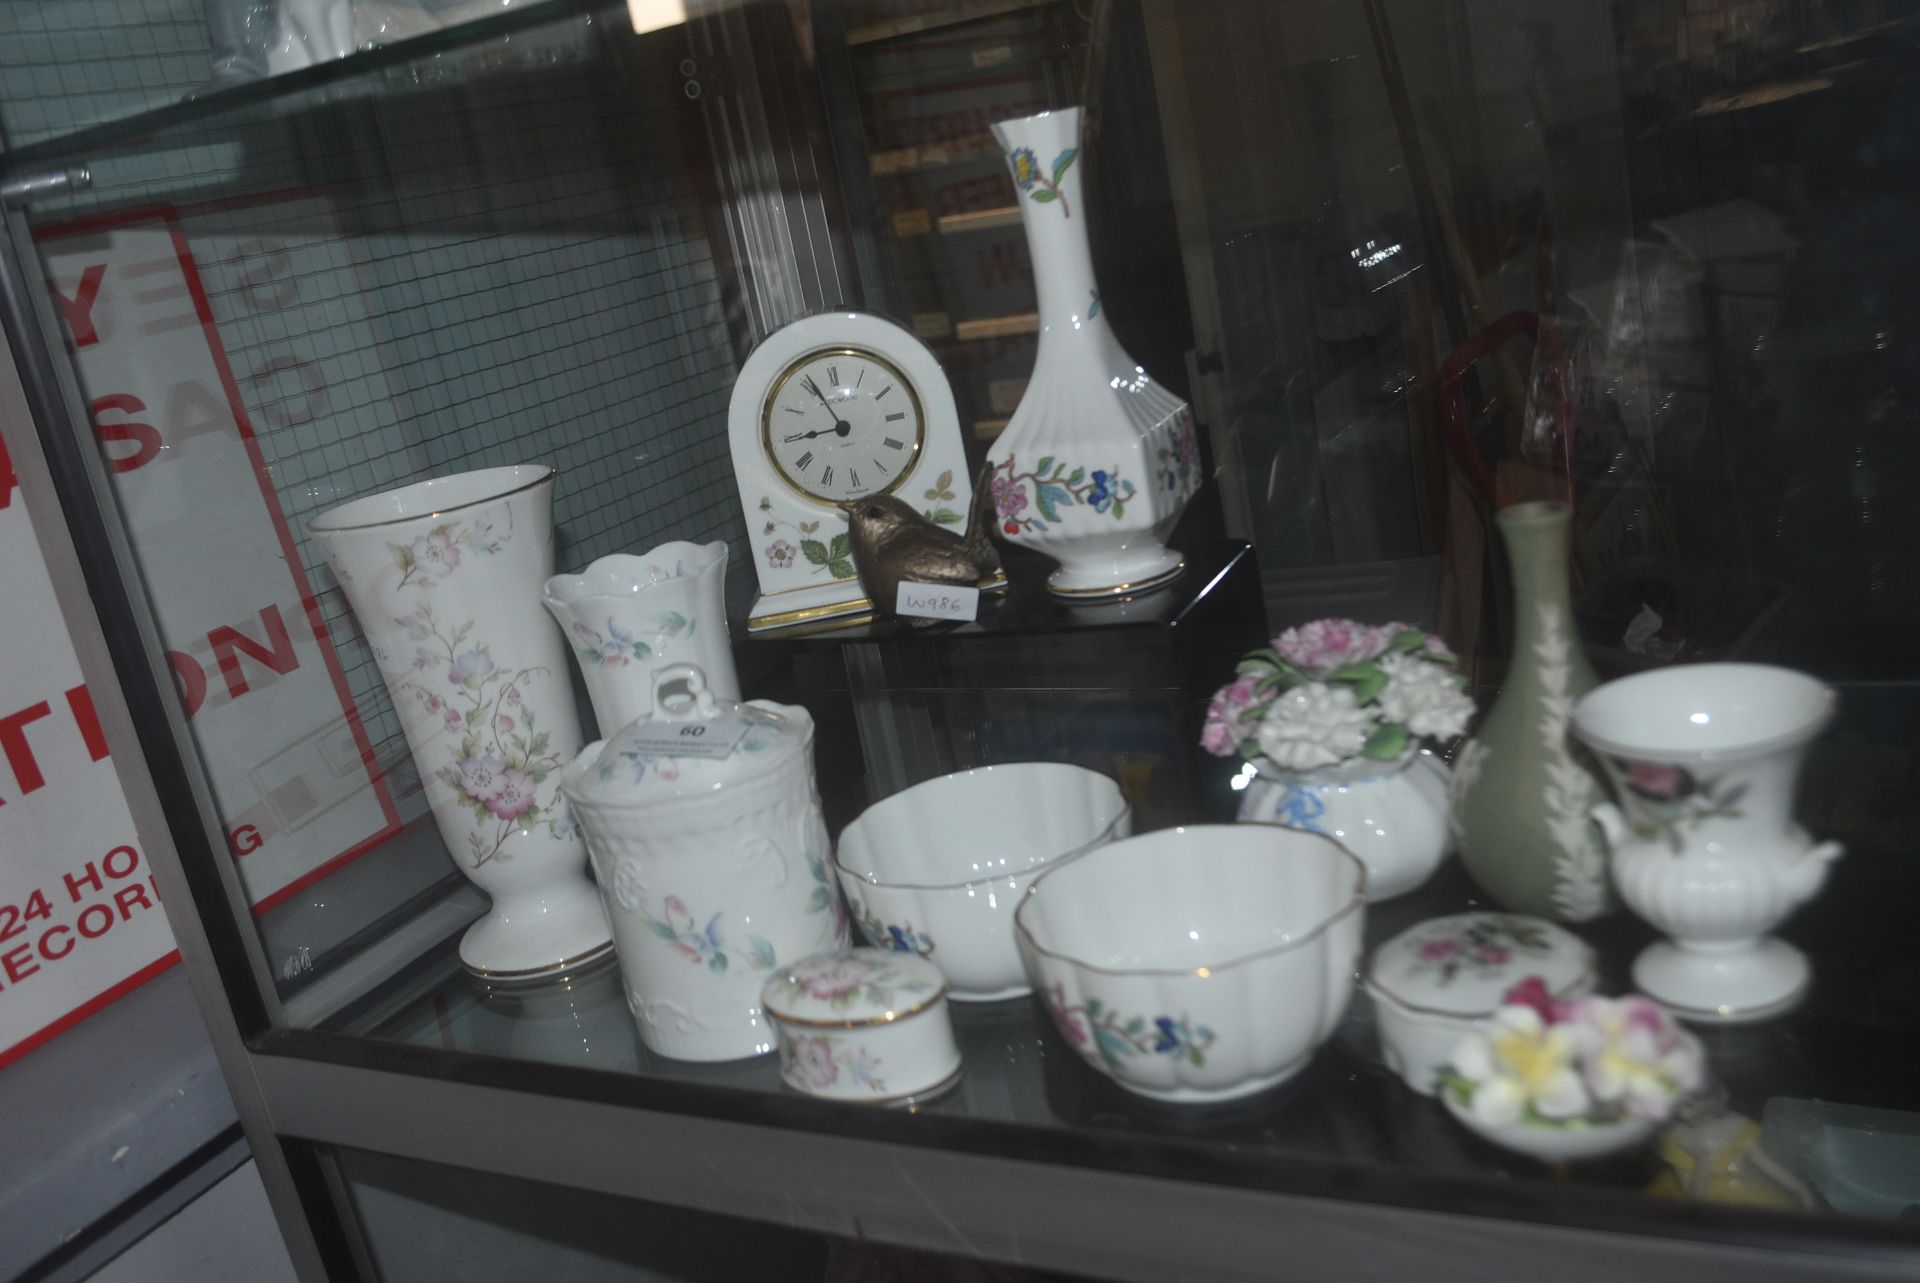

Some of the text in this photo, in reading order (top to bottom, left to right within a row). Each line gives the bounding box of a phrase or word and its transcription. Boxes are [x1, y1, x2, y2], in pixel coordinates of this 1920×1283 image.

[680, 724, 706, 737] 60
[0, 844, 139, 940] 24 HO
